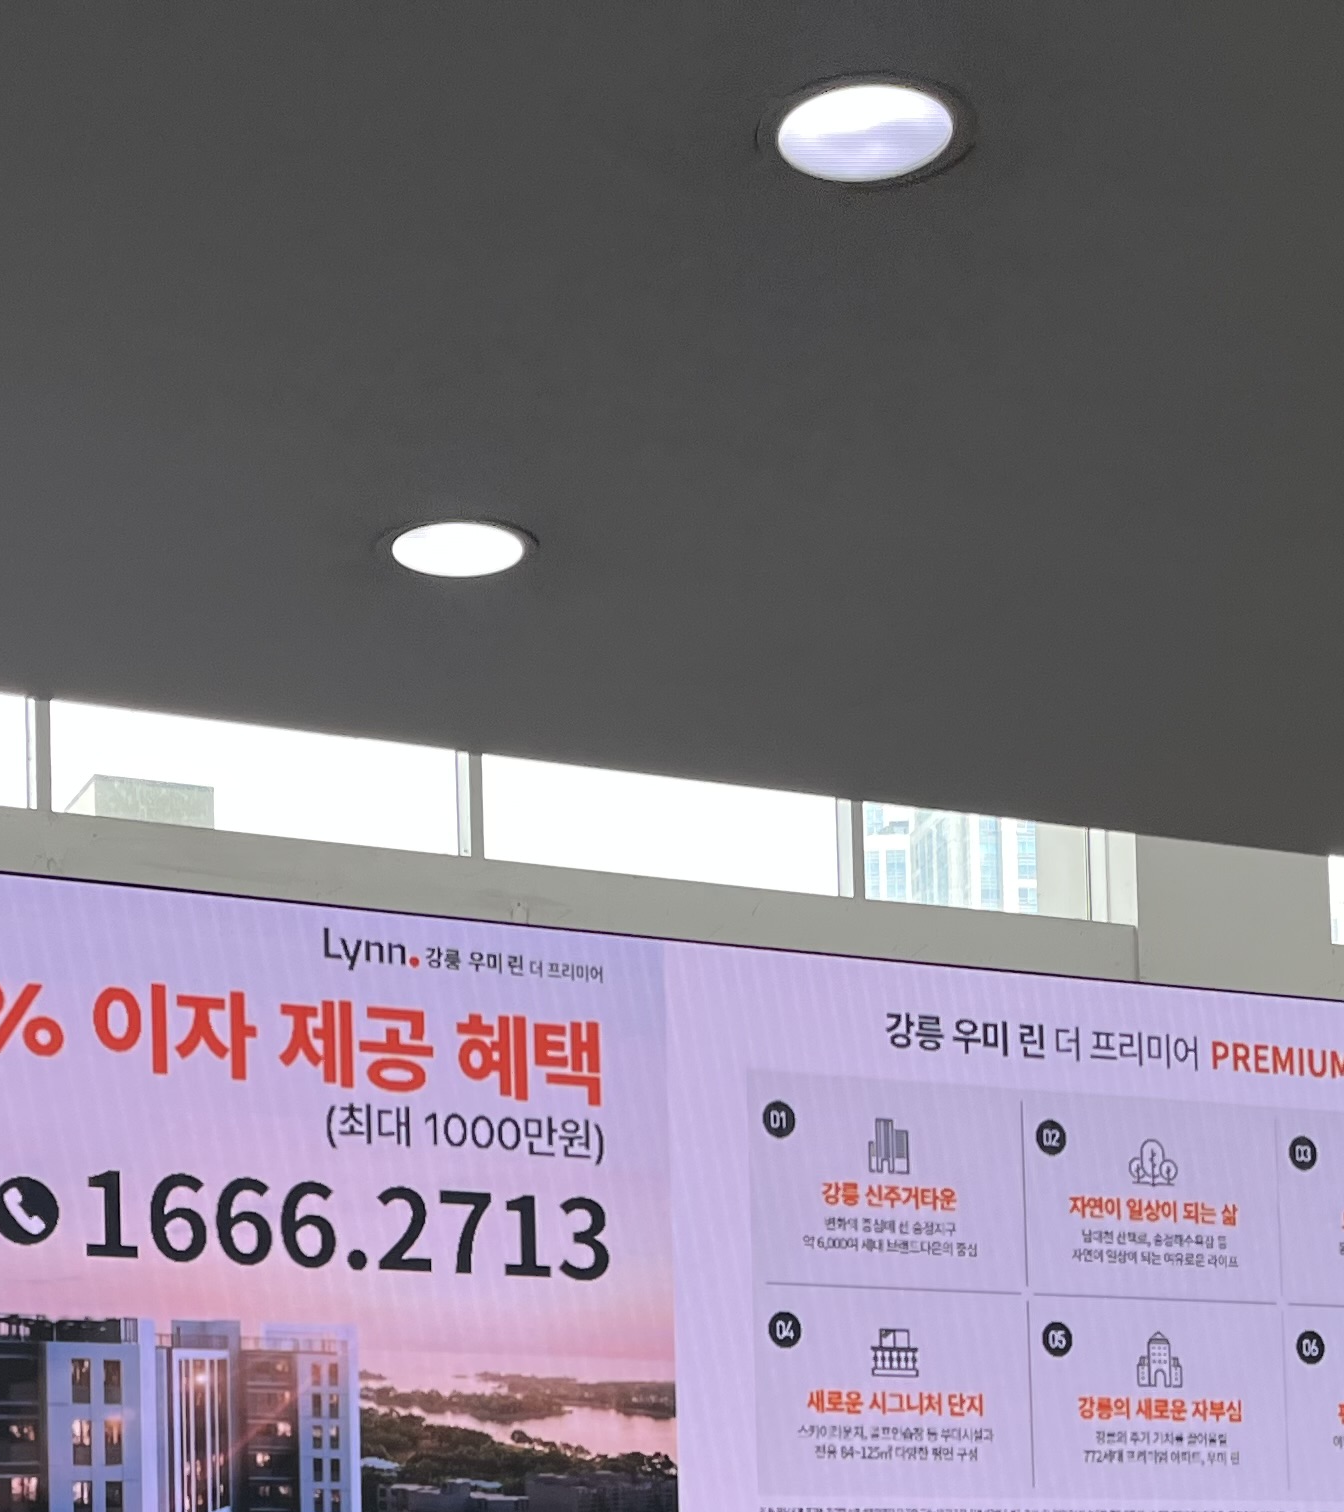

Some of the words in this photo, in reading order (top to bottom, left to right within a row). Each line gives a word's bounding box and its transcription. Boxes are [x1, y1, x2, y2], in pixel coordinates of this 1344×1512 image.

[425, 947, 461, 970] 강릉
[468, 952, 502, 974] 우미
[508, 955, 524, 977] 린
[530, 960, 543, 978] 더
[548, 962, 604, 984] 프리미어
[93, 982, 257, 1081] 이자
[278, 999, 434, 1093] 제공
[456, 1012, 603, 1107] 혜택
[885, 1011, 944, 1052] 강릉
[953, 1018, 1008, 1056] 우미
[1019, 1023, 1046, 1060] 린
[1056, 1026, 1080, 1062] 더
[1090, 1030, 1199, 1072] 프리미어
[326, 1102, 412, 1151] (최대
[424, 1111, 606, 1165] 1000만원)
[822, 1182, 860, 1206] 강릉
[865, 1185, 957, 1211] 신주거타운
[1069, 1196, 1121, 1220] 자연이
[1126, 1198, 1178, 1223] 일상이
[1183, 1202, 1216, 1225] 되는
[1221, 1204, 1239, 1227] 삶
[86, 1170, 611, 1281] 1666.2713
[775, 1320, 795, 1340] 04
[1302, 1339, 1319, 1357] 06
[807, 1389, 864, 1415] 새로운
[869, 1391, 943, 1416] 시그니처
[948, 1393, 984, 1417] 단지
[1078, 1396, 1131, 1420] 강릉의
[1136, 1397, 1187, 1421] 새로운
[1192, 1399, 1243, 1423] 자부심
